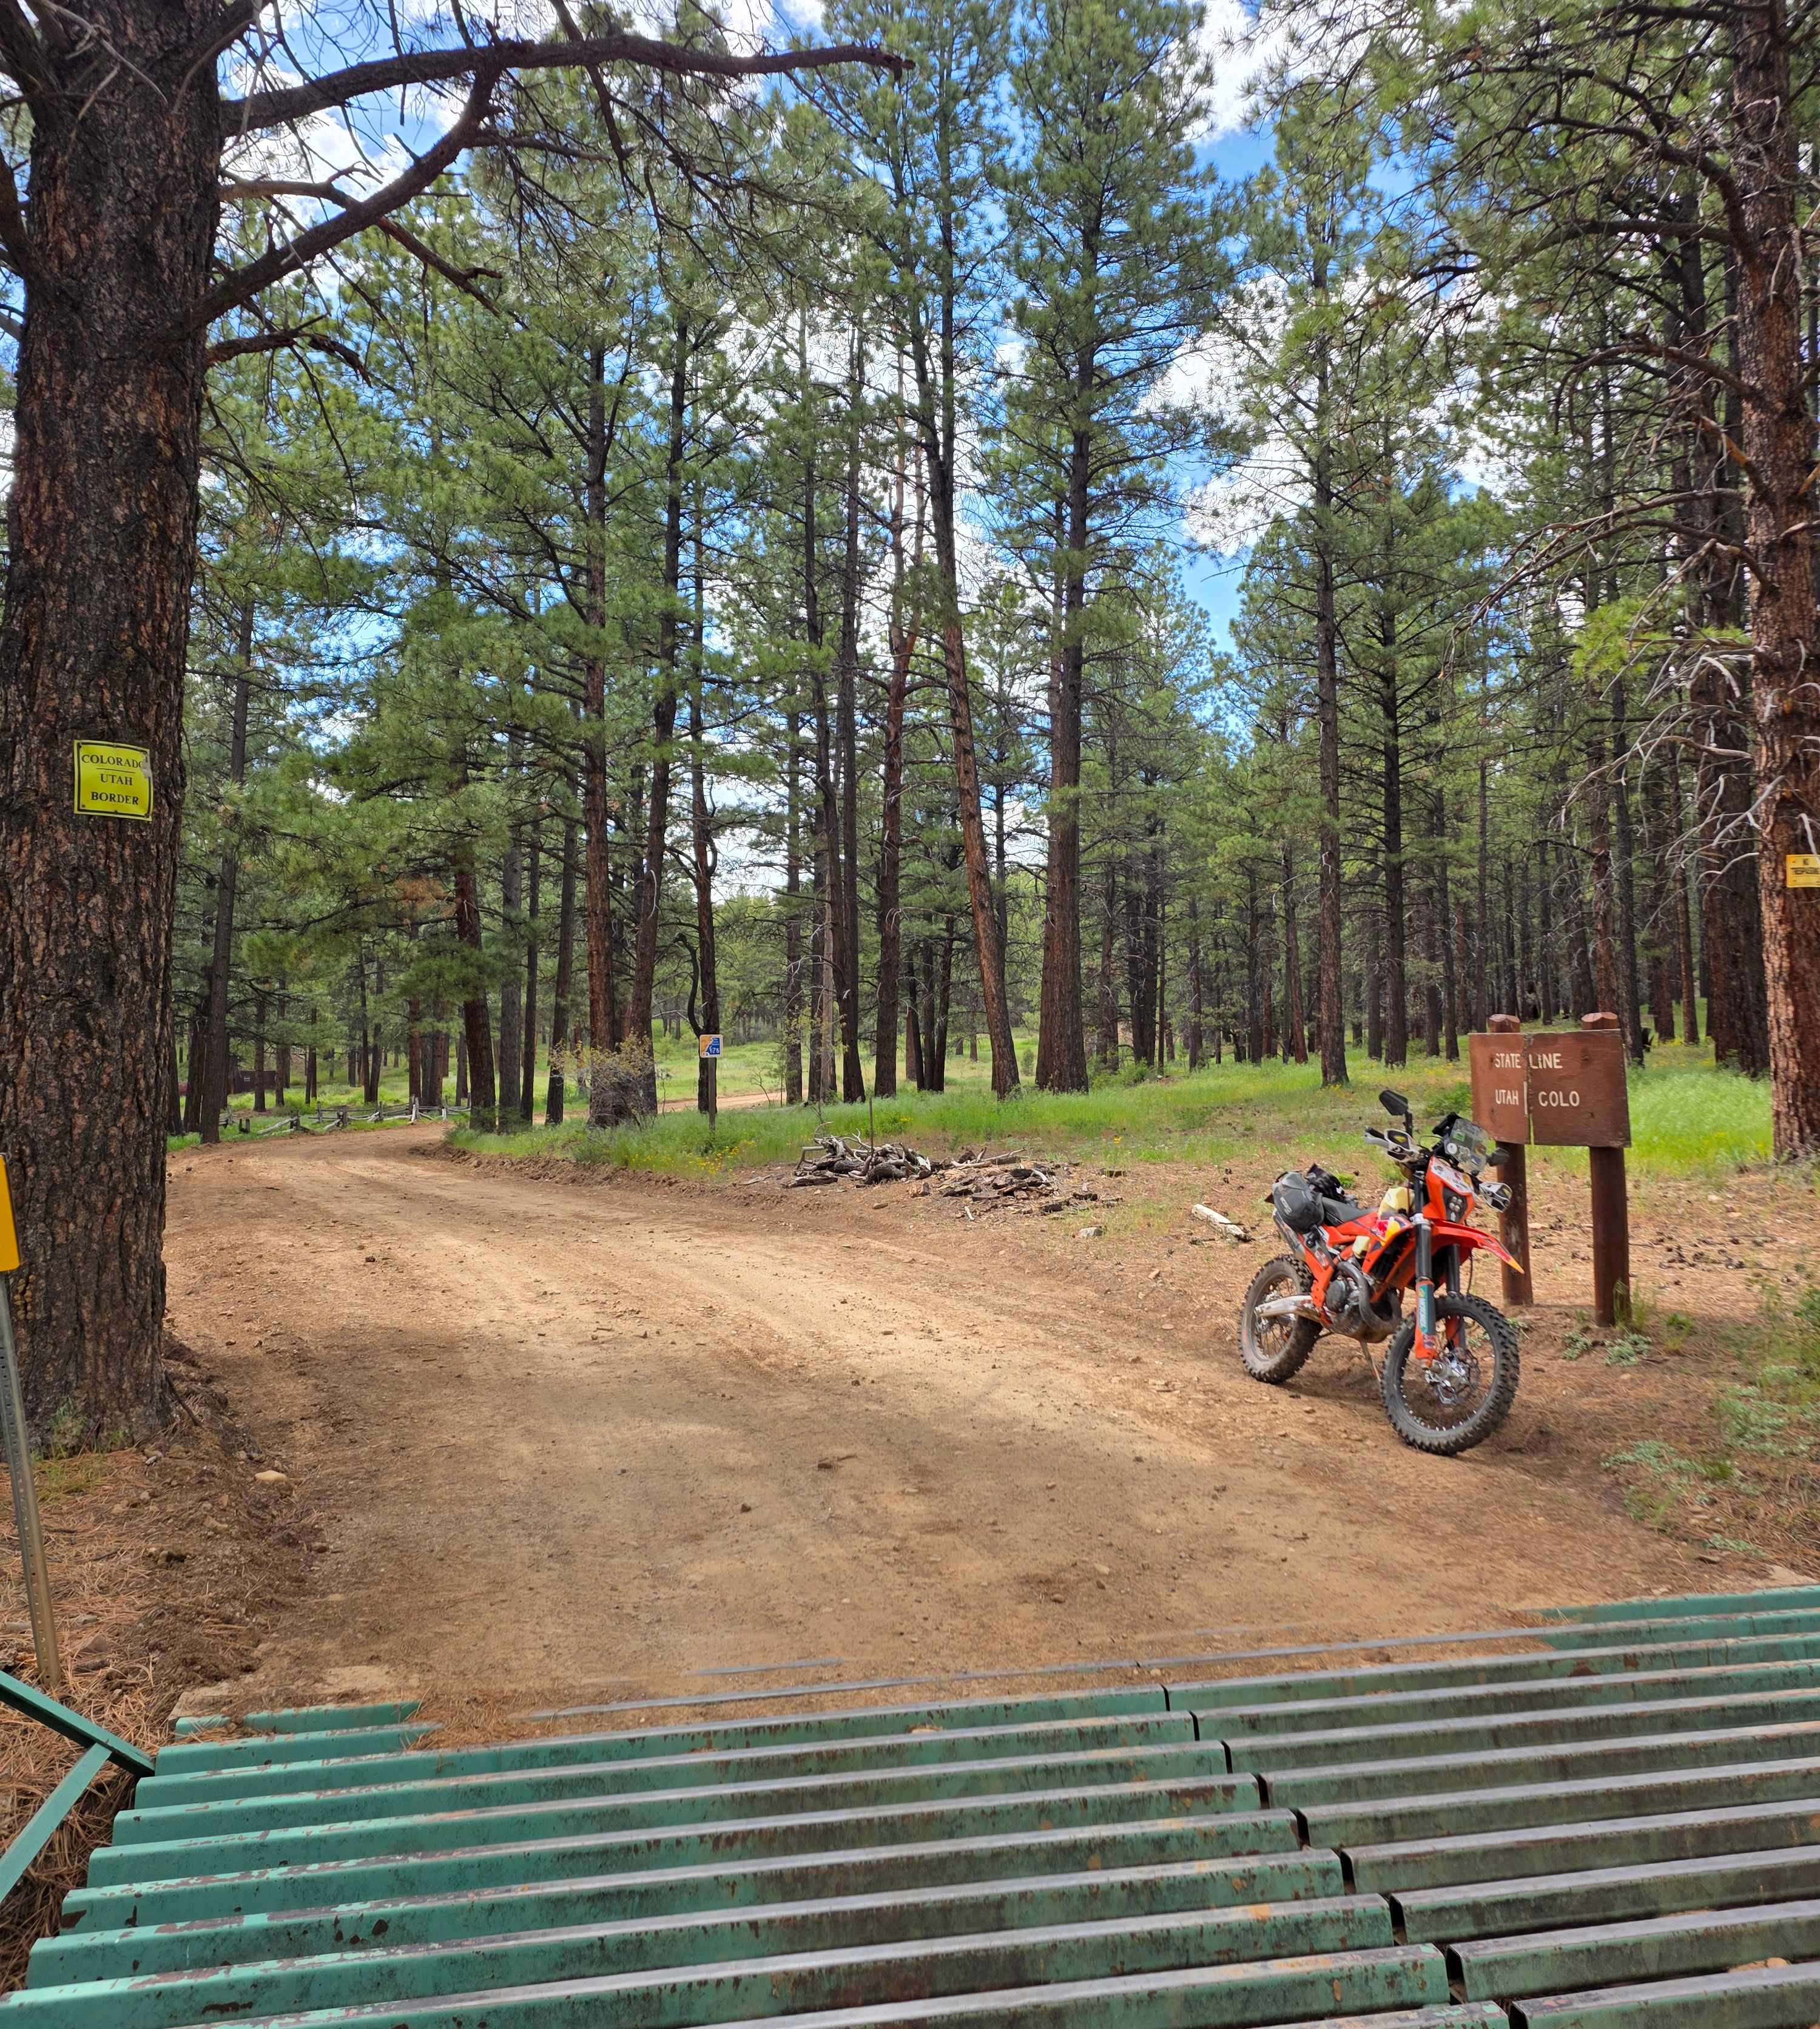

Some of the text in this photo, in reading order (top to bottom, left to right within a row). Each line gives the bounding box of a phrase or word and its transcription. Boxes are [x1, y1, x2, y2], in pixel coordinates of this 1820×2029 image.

[100, 774, 132, 786] UTAH
[91, 791, 139, 805] BORDER
[1494, 1053, 1563, 1069] STATE LINE
[1495, 1089, 1580, 1107] UTAH COLO
